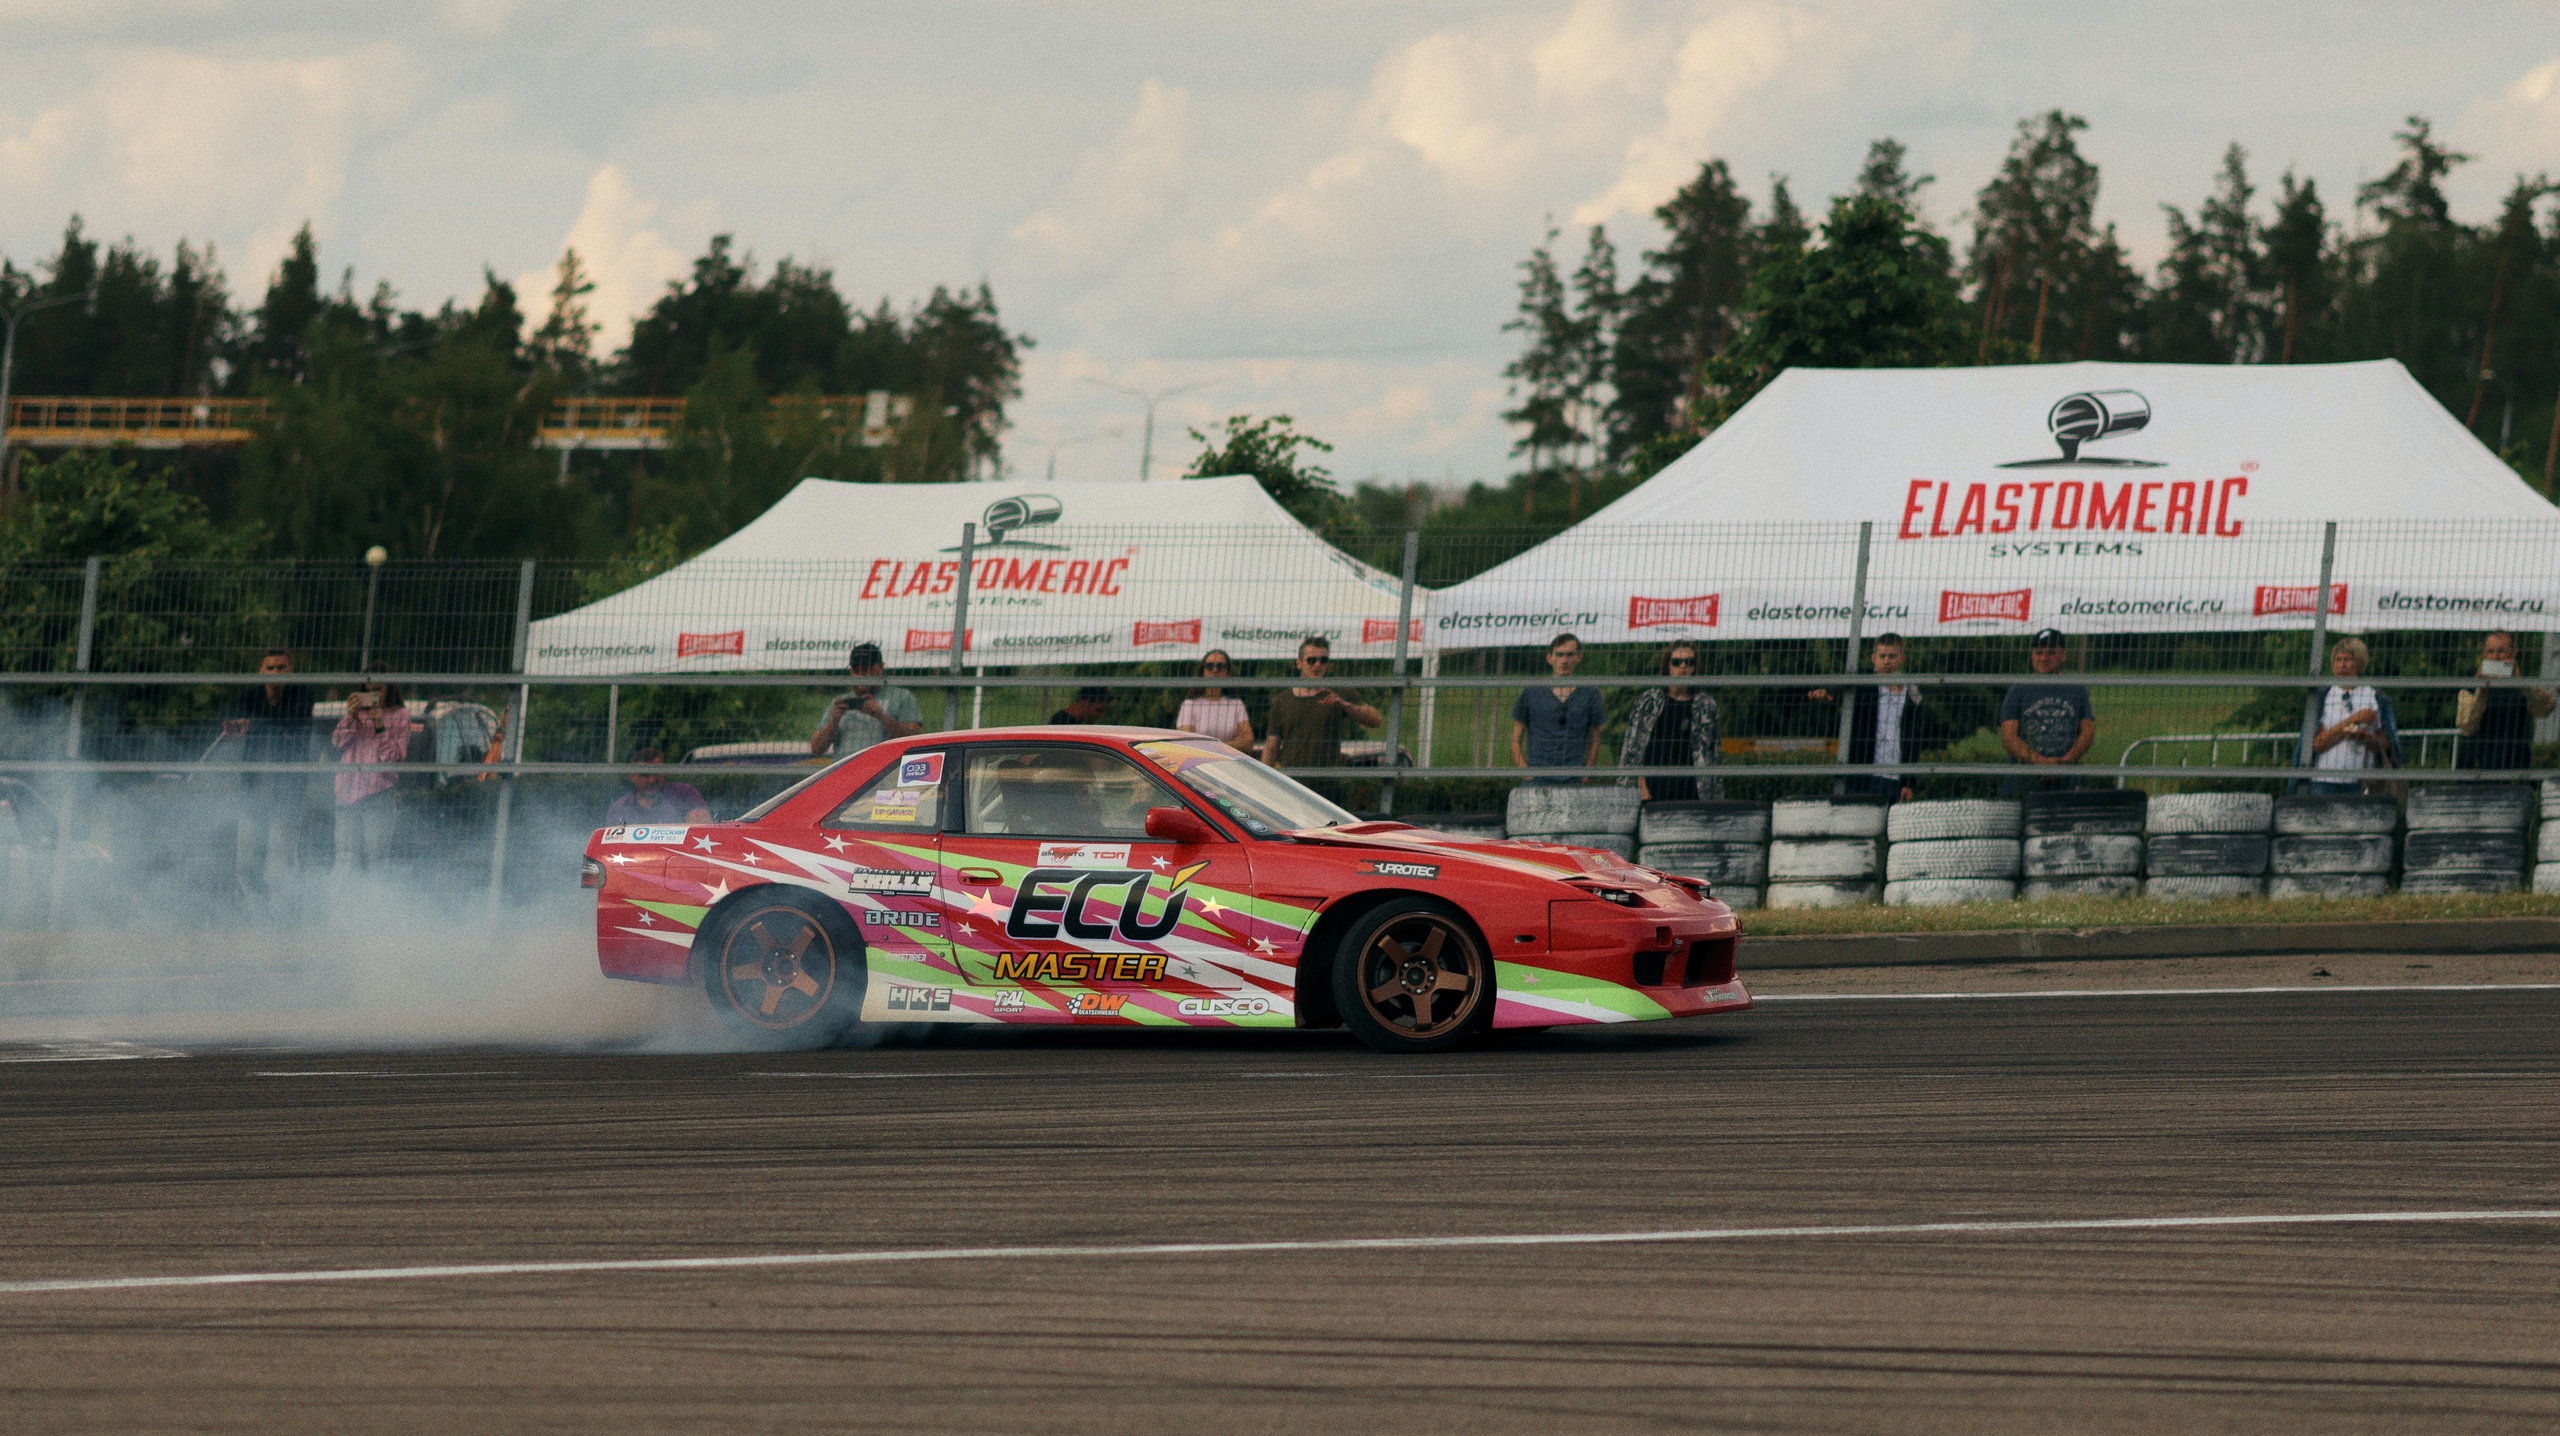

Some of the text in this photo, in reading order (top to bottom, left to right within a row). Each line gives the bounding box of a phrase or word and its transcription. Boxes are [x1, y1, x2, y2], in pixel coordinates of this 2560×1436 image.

[1898, 477, 2248, 540] ELASTOMERIC
[1989, 542, 2144, 558] SYSTEMS
[927, 596, 1044, 609] SYTEMS
[1748, 601, 1909, 621] elastomeic.ru
[2060, 595, 2224, 615] elastomeric.ru
[2378, 591, 2544, 613] elastomeric.ru
[1439, 608, 1598, 630] elastomeric.ru
[993, 632, 1112, 648] elastomeric.ru
[538, 643, 656, 659] elastomeric.ru
[849, 873, 935, 892] SKILLS
[1005, 865, 1191, 942] ECU
[864, 910, 941, 927] BRIDE
[994, 952, 1169, 981] MASTER
[889, 987, 952, 1006] HKS
[1080, 993, 1129, 1010] DW
[1178, 998, 1270, 1016] CUSCO
